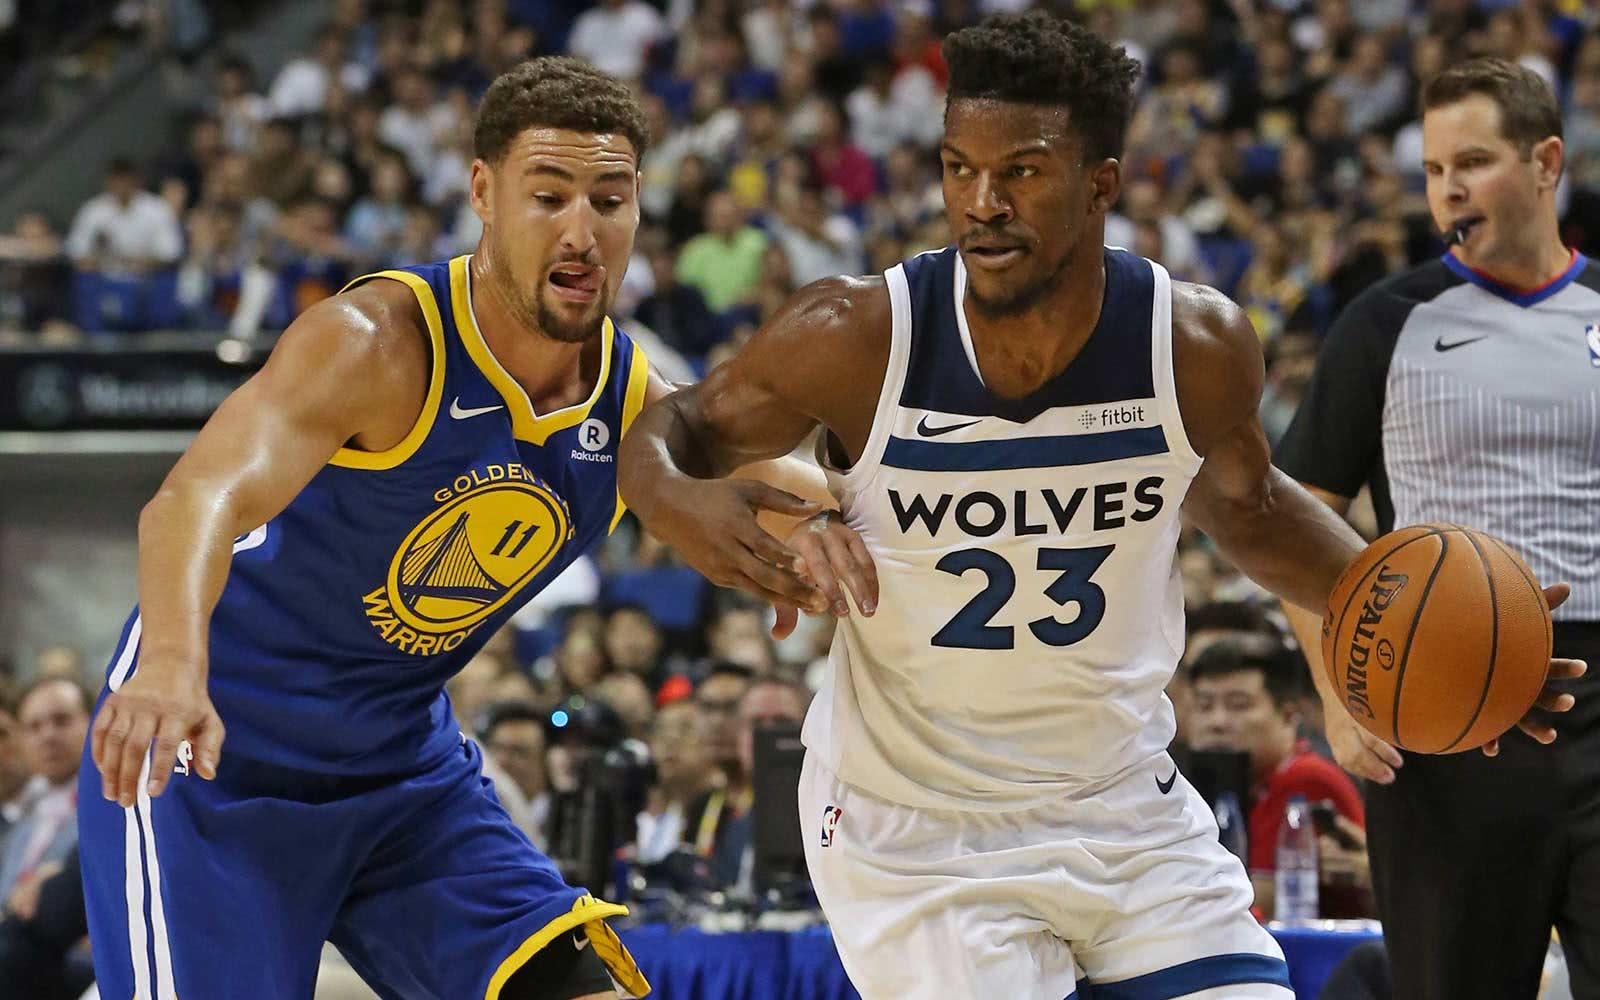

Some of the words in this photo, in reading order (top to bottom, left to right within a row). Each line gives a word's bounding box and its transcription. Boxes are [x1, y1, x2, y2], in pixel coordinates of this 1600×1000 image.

[587, 425, 600, 445] R
[1101, 406, 1145, 426] fitbit
[571, 449, 613, 463] Rakuten
[434, 463, 536, 502] GOLDEN
[887, 476, 1165, 537] WOLVES
[490, 519, 541, 559] 11
[930, 544, 1116, 650] 23
[362, 585, 487, 657] WARRIO
[1346, 564, 1409, 720] SPALDING
